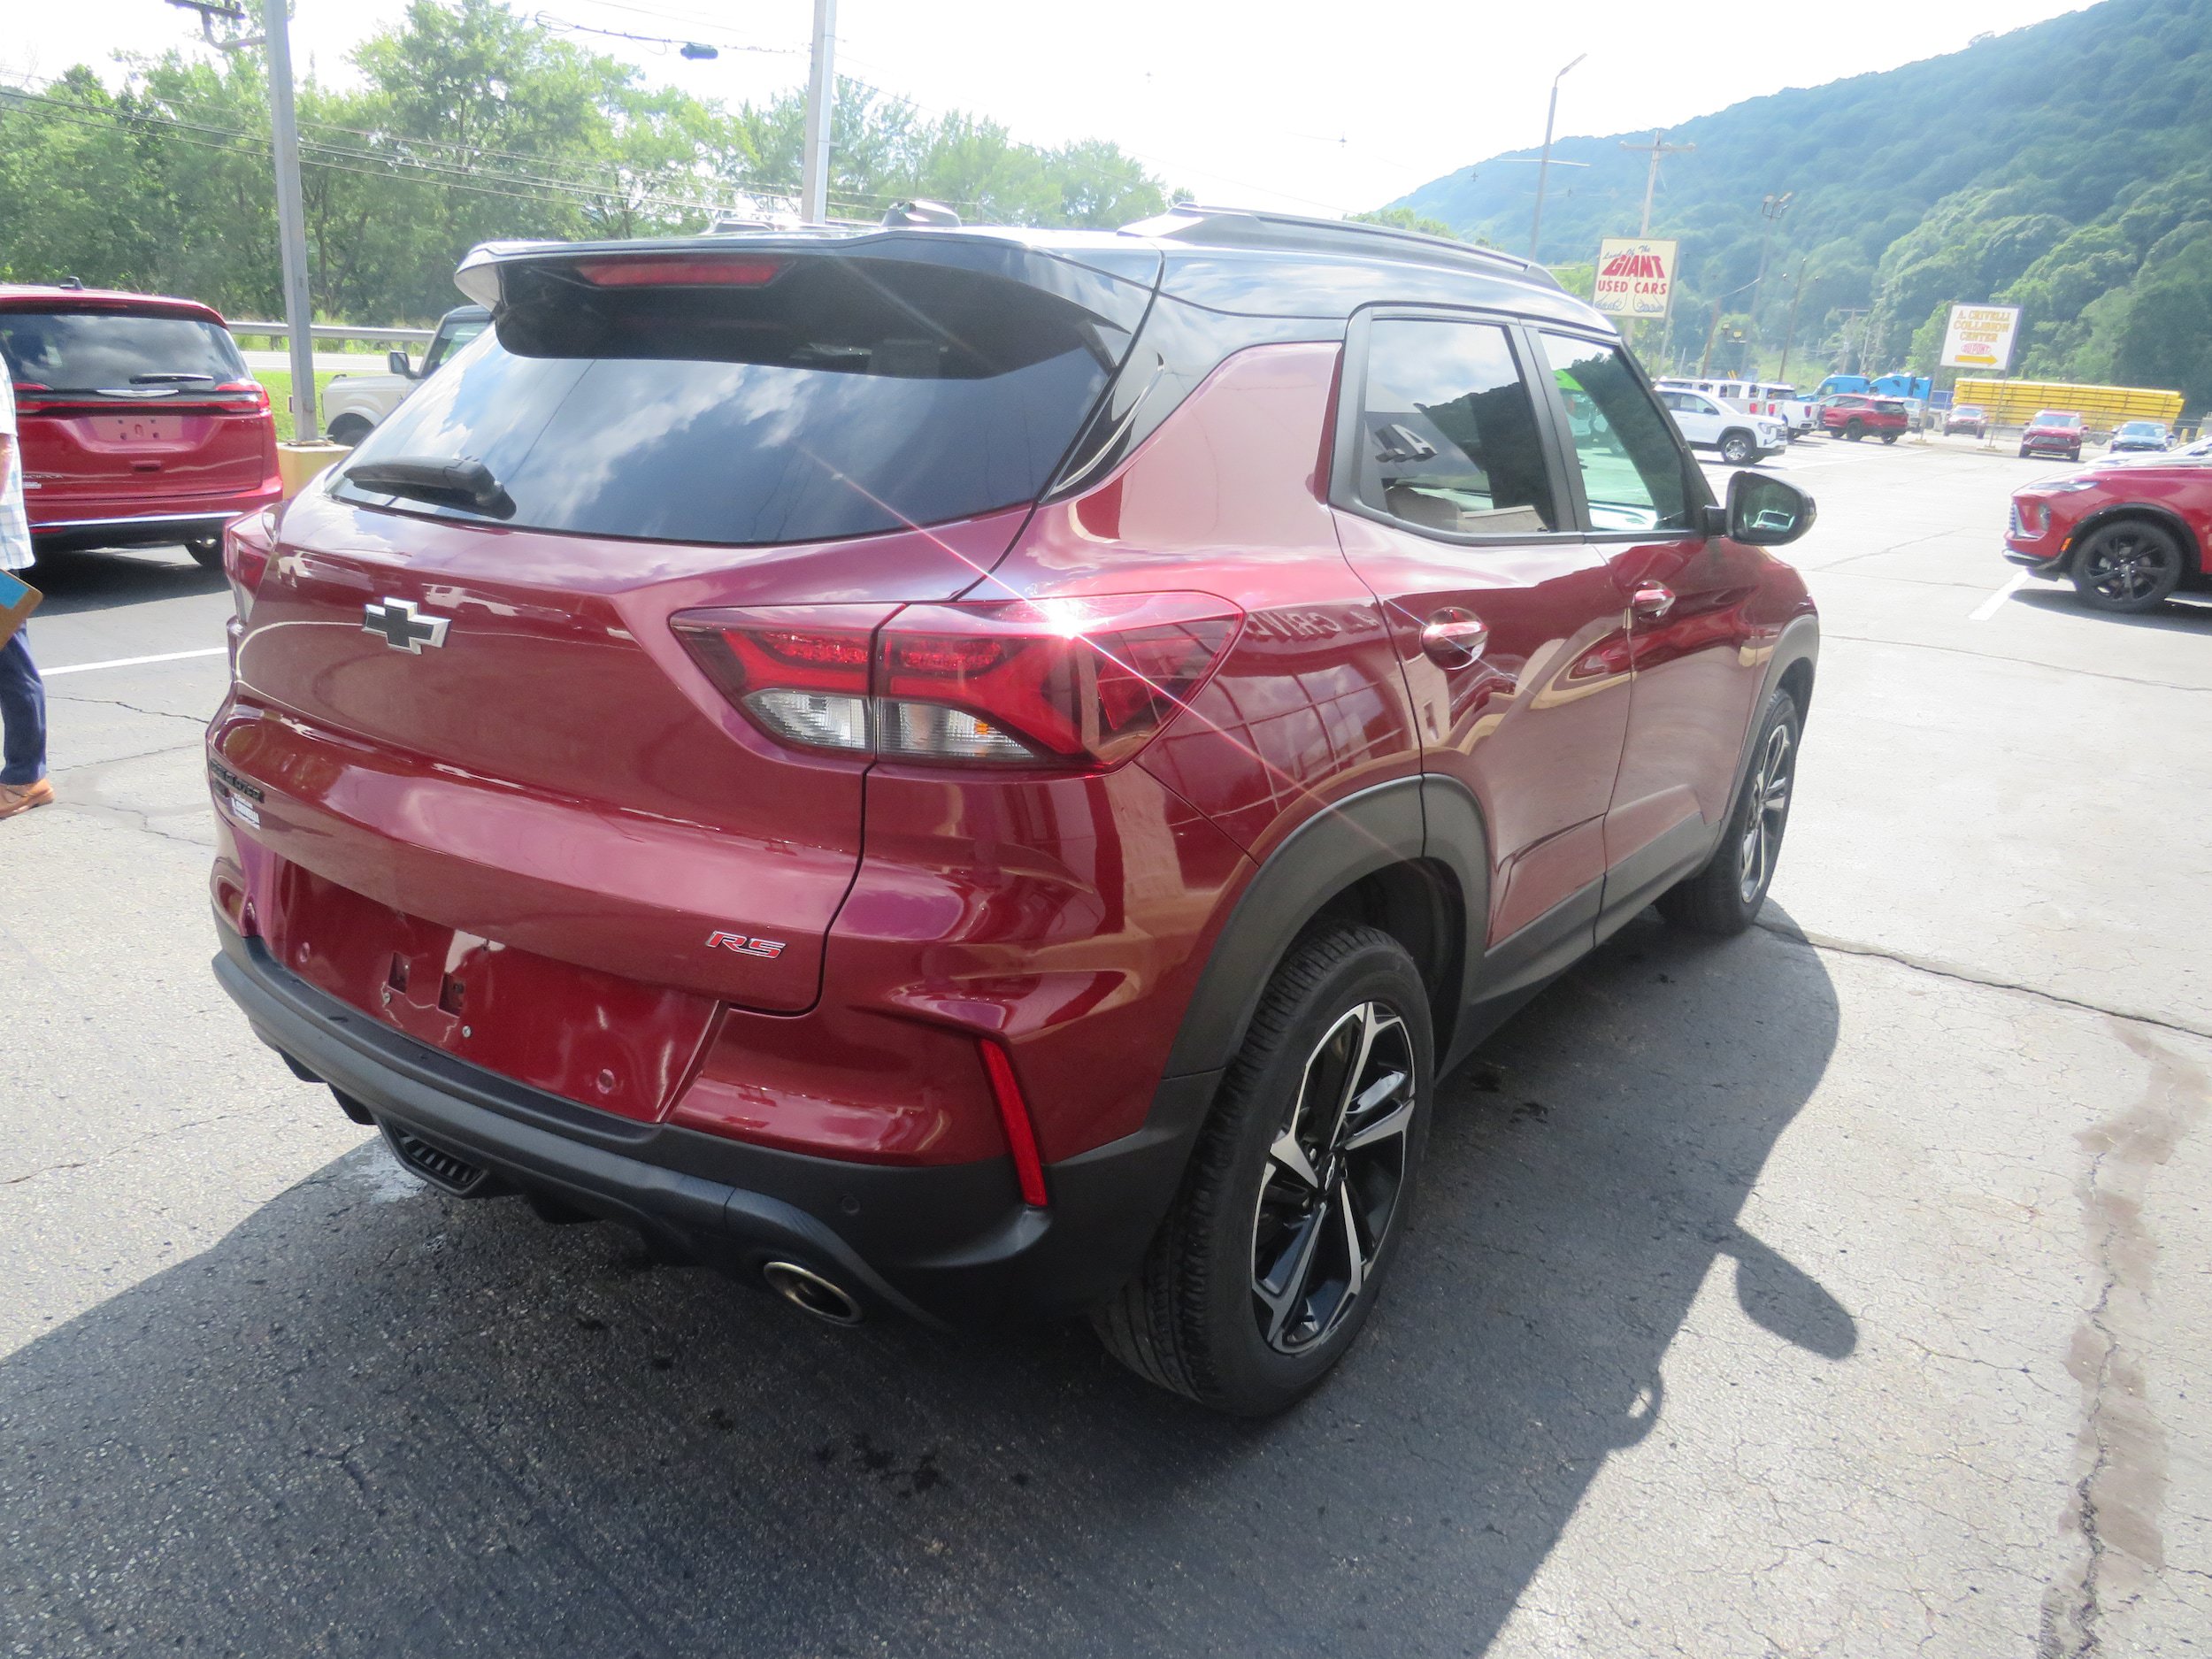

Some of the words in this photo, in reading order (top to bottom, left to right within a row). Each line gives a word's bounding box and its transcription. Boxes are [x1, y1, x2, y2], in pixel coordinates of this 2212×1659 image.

[1601, 255, 1665, 279] GIANT
[1598, 280, 1628, 293] USED
[1634, 282, 1667, 295] CARS
[1954, 320, 2010, 333] COLLISION
[1960, 332, 1998, 342] CENTER
[706, 931, 786, 958] RS
